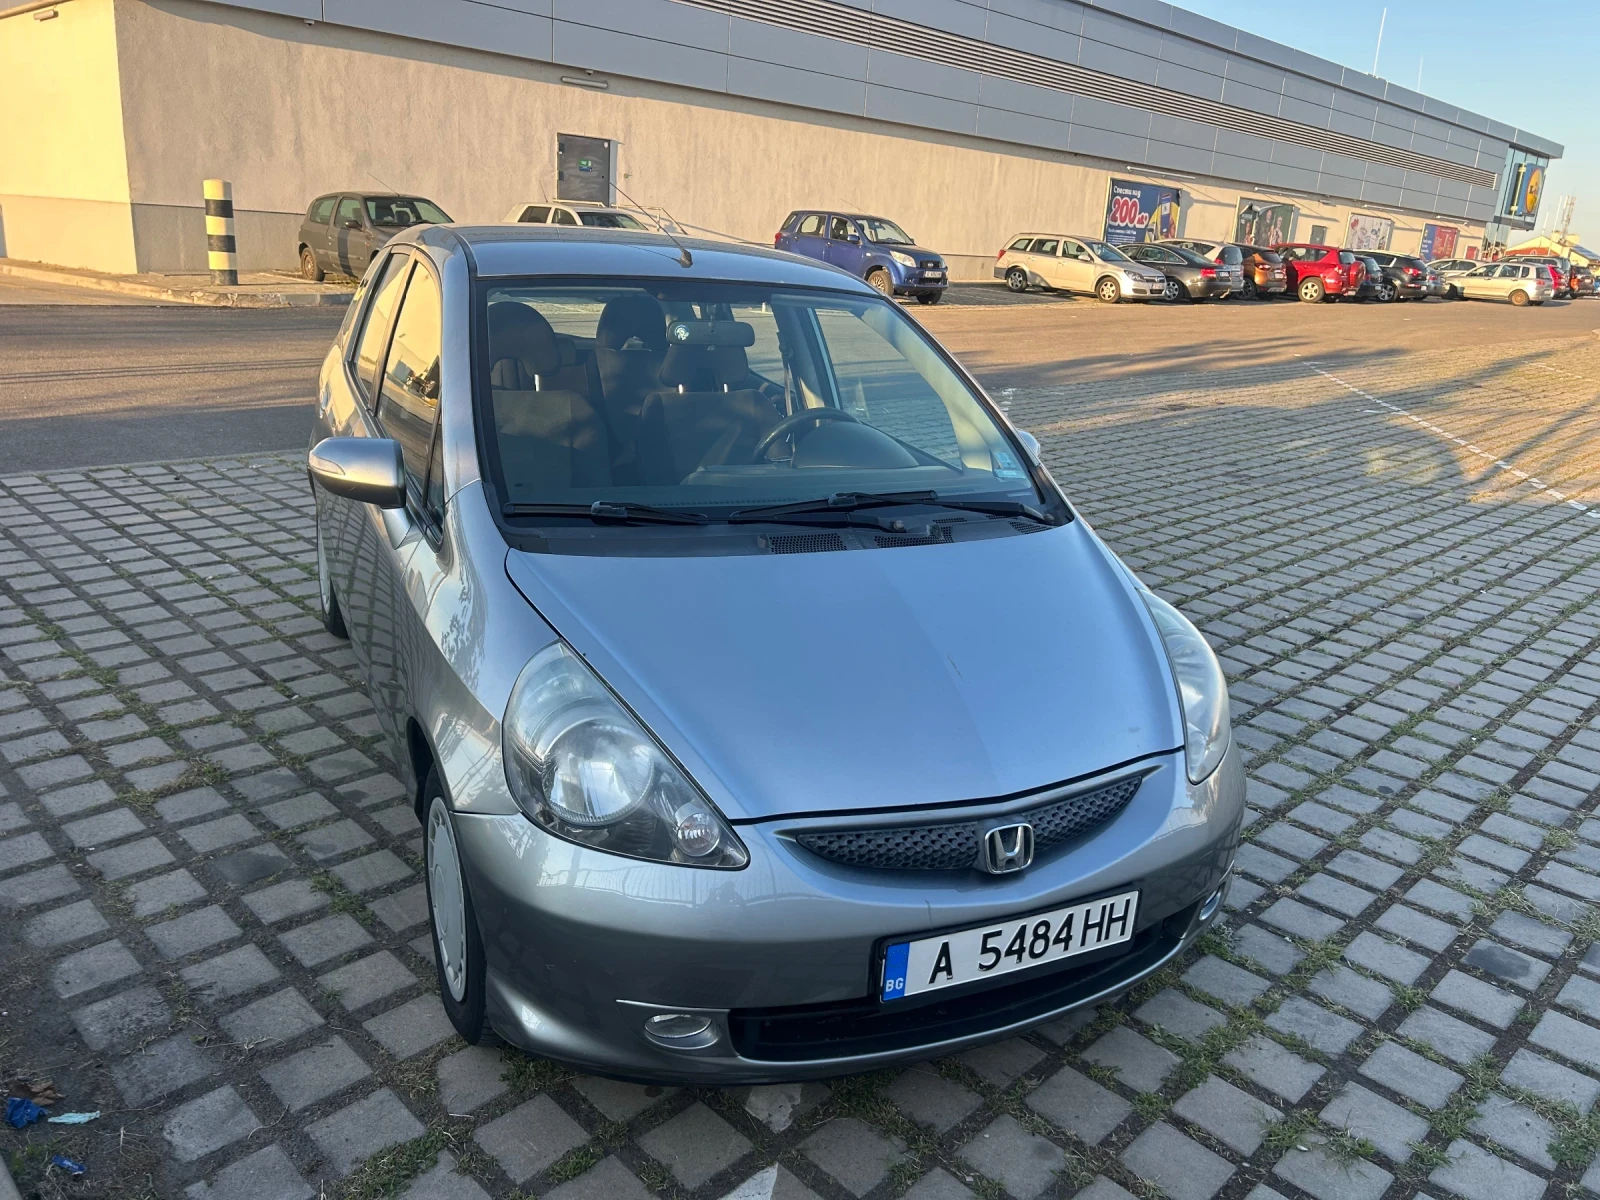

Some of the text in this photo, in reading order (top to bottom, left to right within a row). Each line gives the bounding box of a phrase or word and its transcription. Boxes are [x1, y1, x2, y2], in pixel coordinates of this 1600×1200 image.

[928, 897, 1131, 985] A 5484 HH
[885, 978, 904, 992] BG
